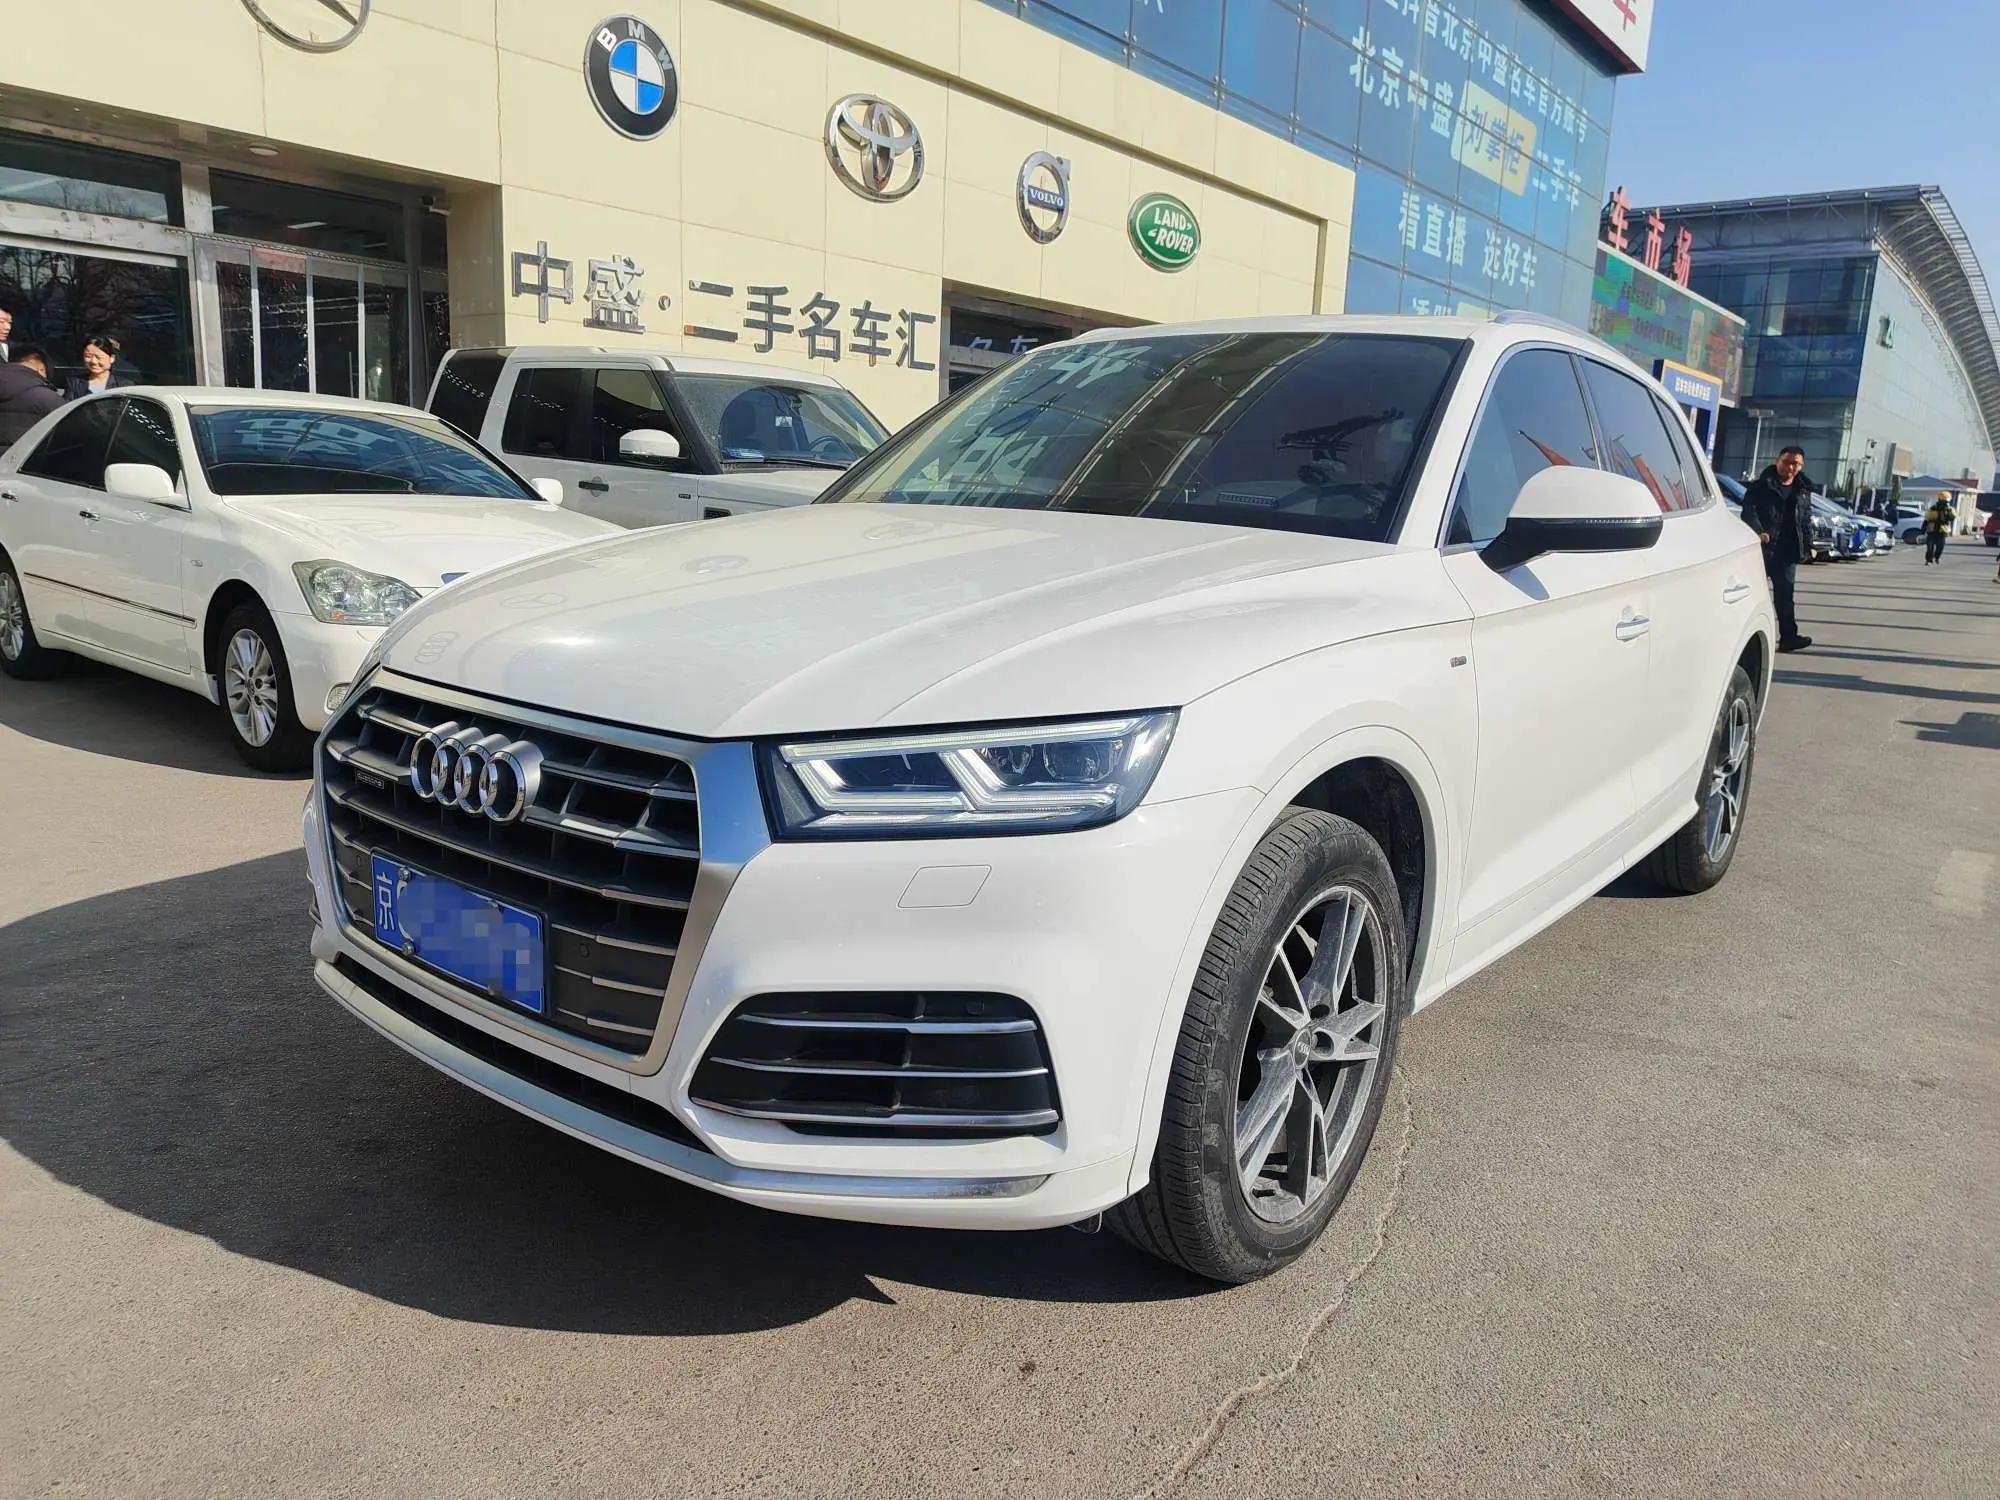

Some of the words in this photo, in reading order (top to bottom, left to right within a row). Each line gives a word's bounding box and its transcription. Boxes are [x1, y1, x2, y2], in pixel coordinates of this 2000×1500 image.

[596, 20, 673, 71] BMW
[1350, 26, 1454, 138] 北京中盛
[1532, 150, 1582, 211] 二手车
[1030, 188, 1064, 207] VOLVO
[1154, 207, 1187, 231] LAND
[1399, 191, 1466, 267] 看直播
[1155, 228, 1194, 254] ROVER
